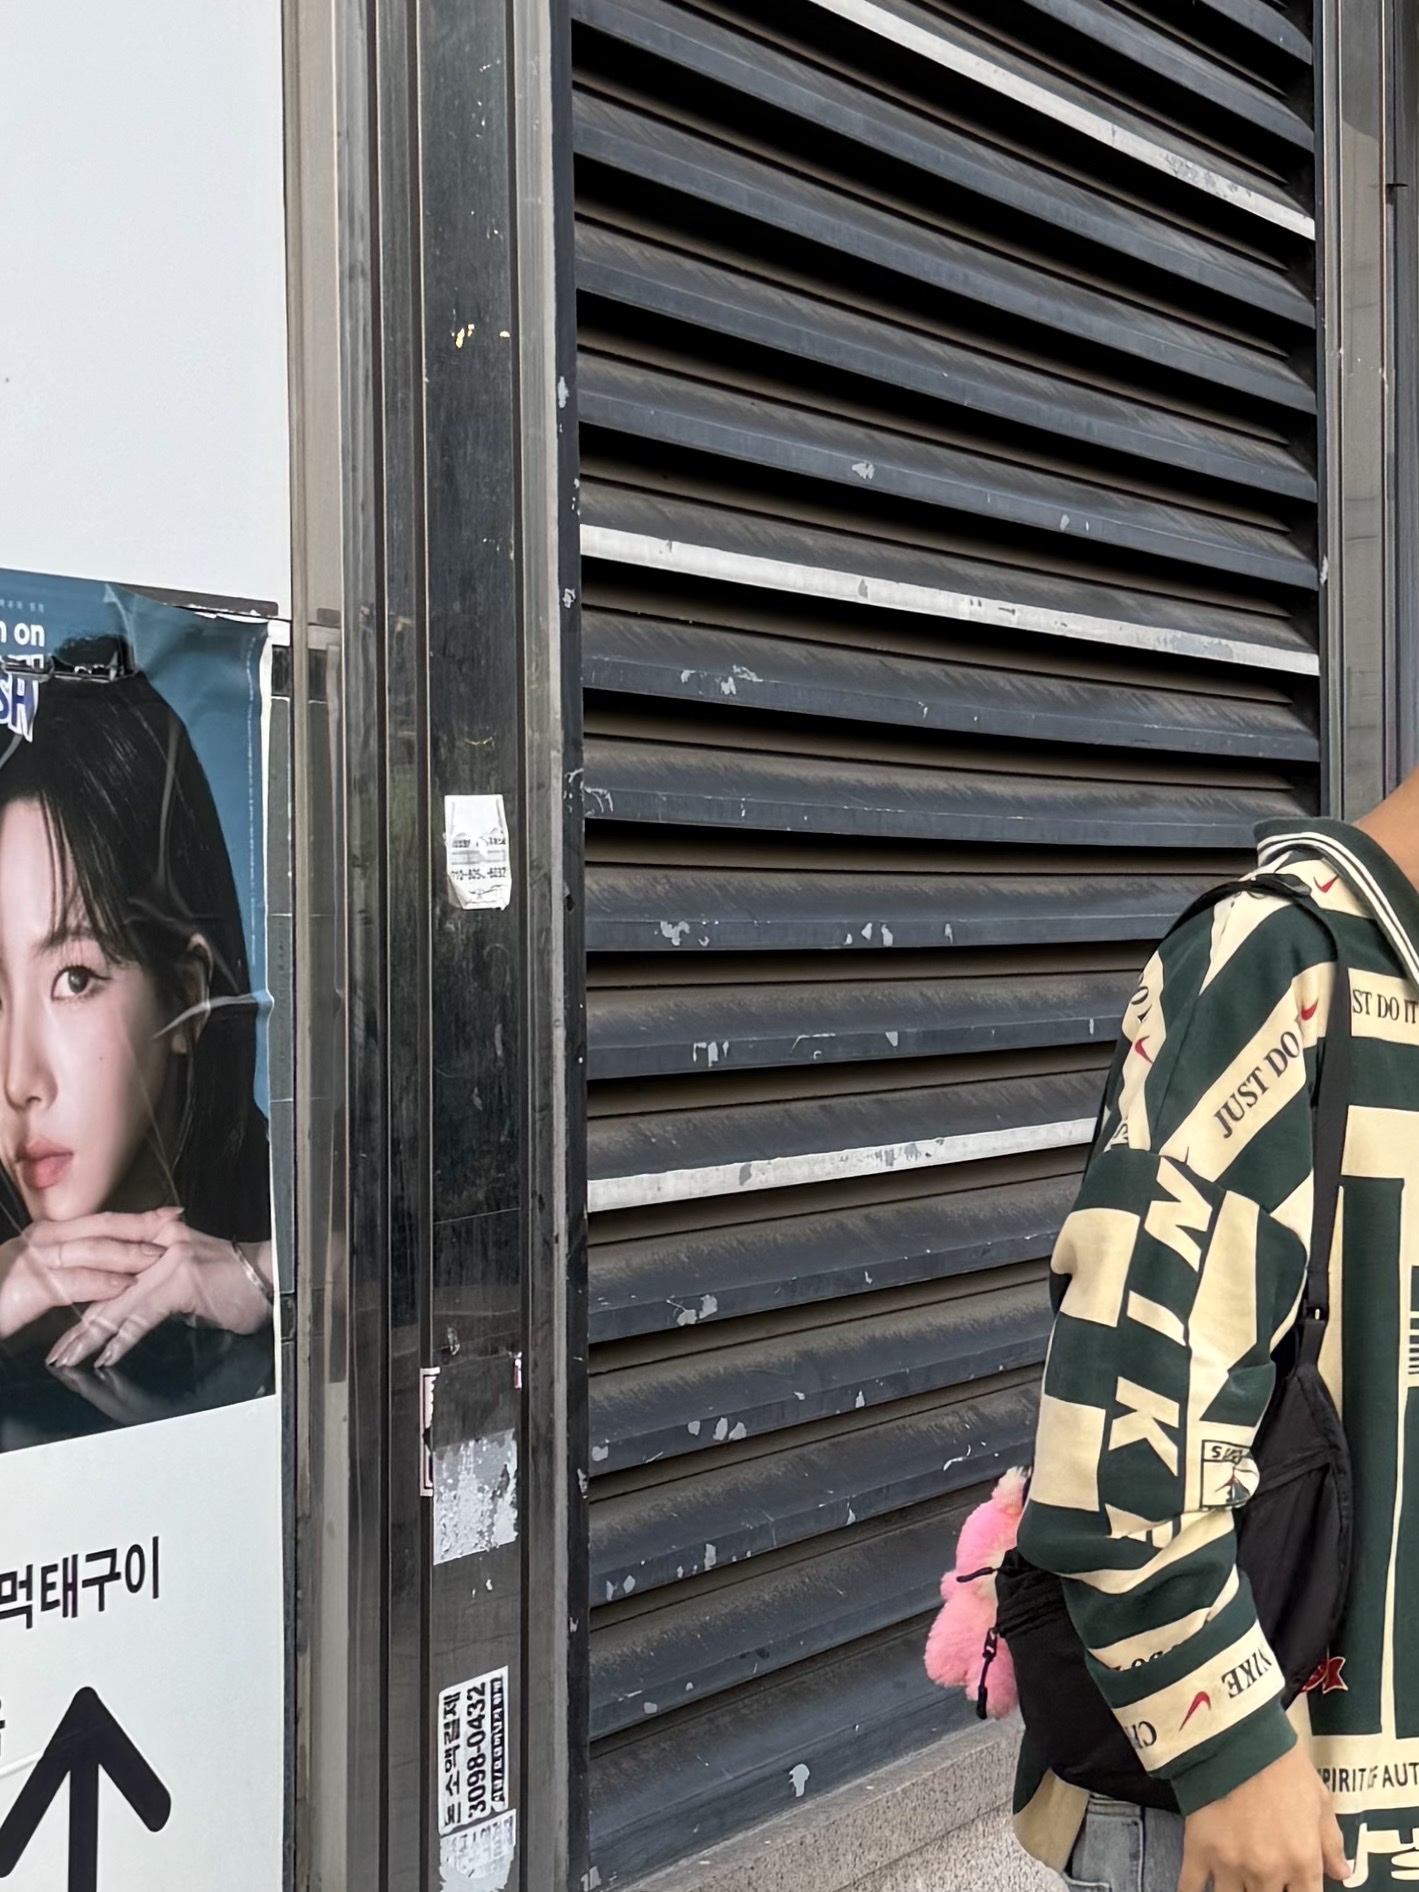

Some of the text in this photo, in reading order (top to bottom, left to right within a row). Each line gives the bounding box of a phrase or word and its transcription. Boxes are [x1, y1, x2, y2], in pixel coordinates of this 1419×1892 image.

[14, 622, 45, 647] on
[1376, 994, 1400, 1022] DO
[1404, 999, 1419, 1024] IT
[1213, 1030, 1301, 1140] JUST DO
[0, 1536, 159, 1629] 먹태구이
[444, 1690, 462, 1798] 소액결제
[466, 1680, 486, 1818] 3098-0432
[1319, 1768, 1366, 1793] PIRIT
